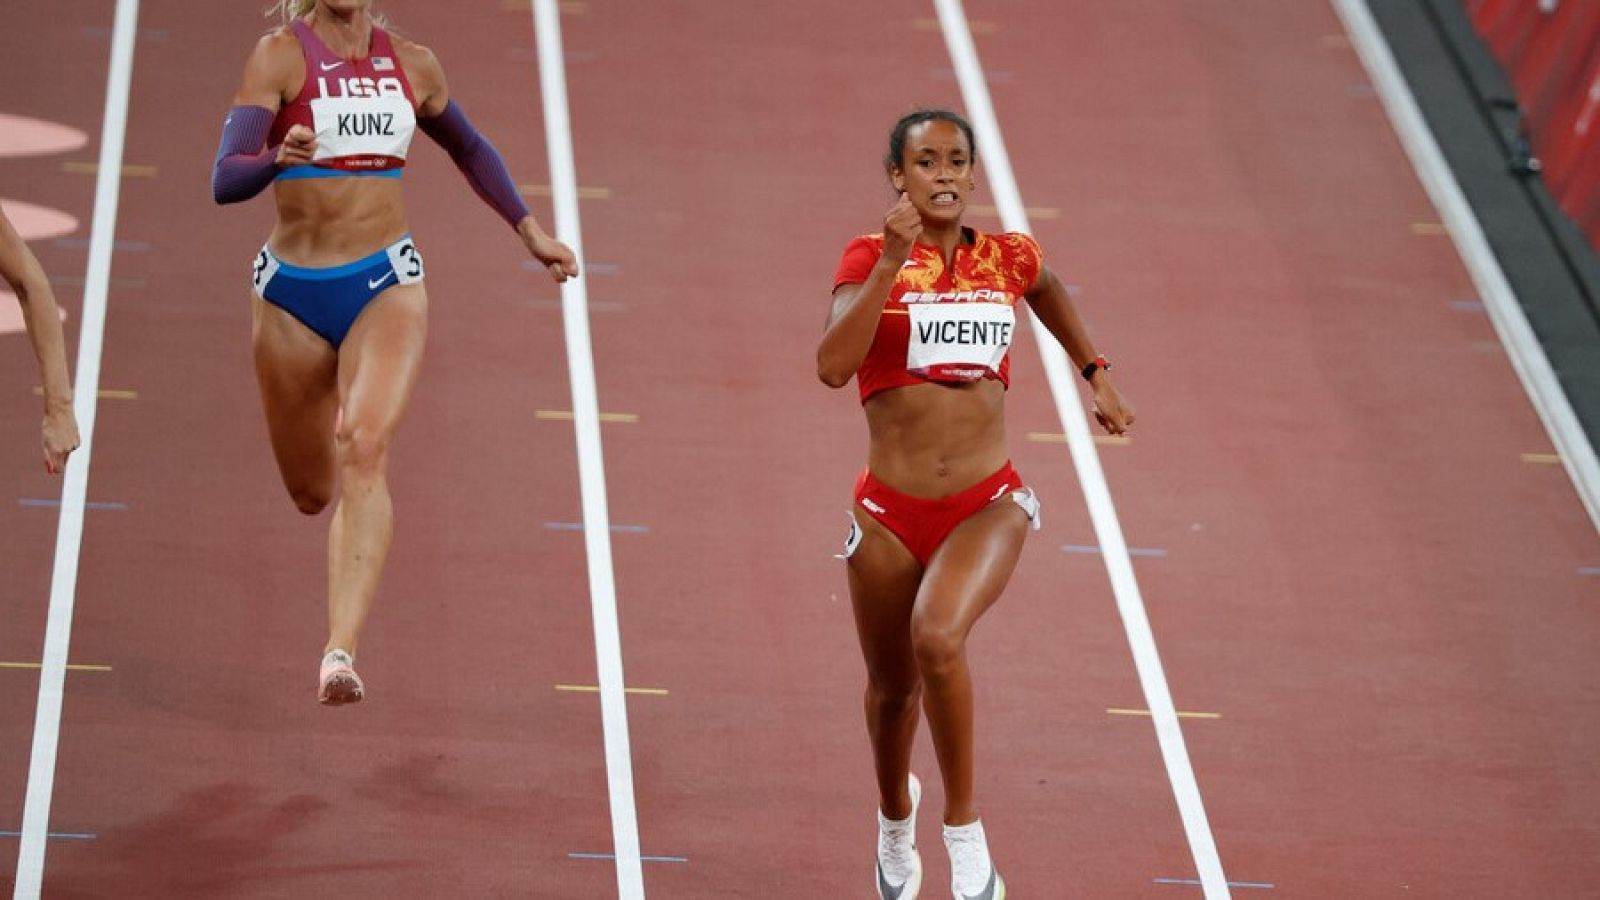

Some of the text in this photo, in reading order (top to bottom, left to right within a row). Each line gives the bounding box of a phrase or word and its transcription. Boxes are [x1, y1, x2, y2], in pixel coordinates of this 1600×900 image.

[318, 77, 404, 98] USA
[337, 113, 395, 136] KUNZ
[400, 244, 421, 277] 3
[917, 321, 1011, 346] VICENTE
